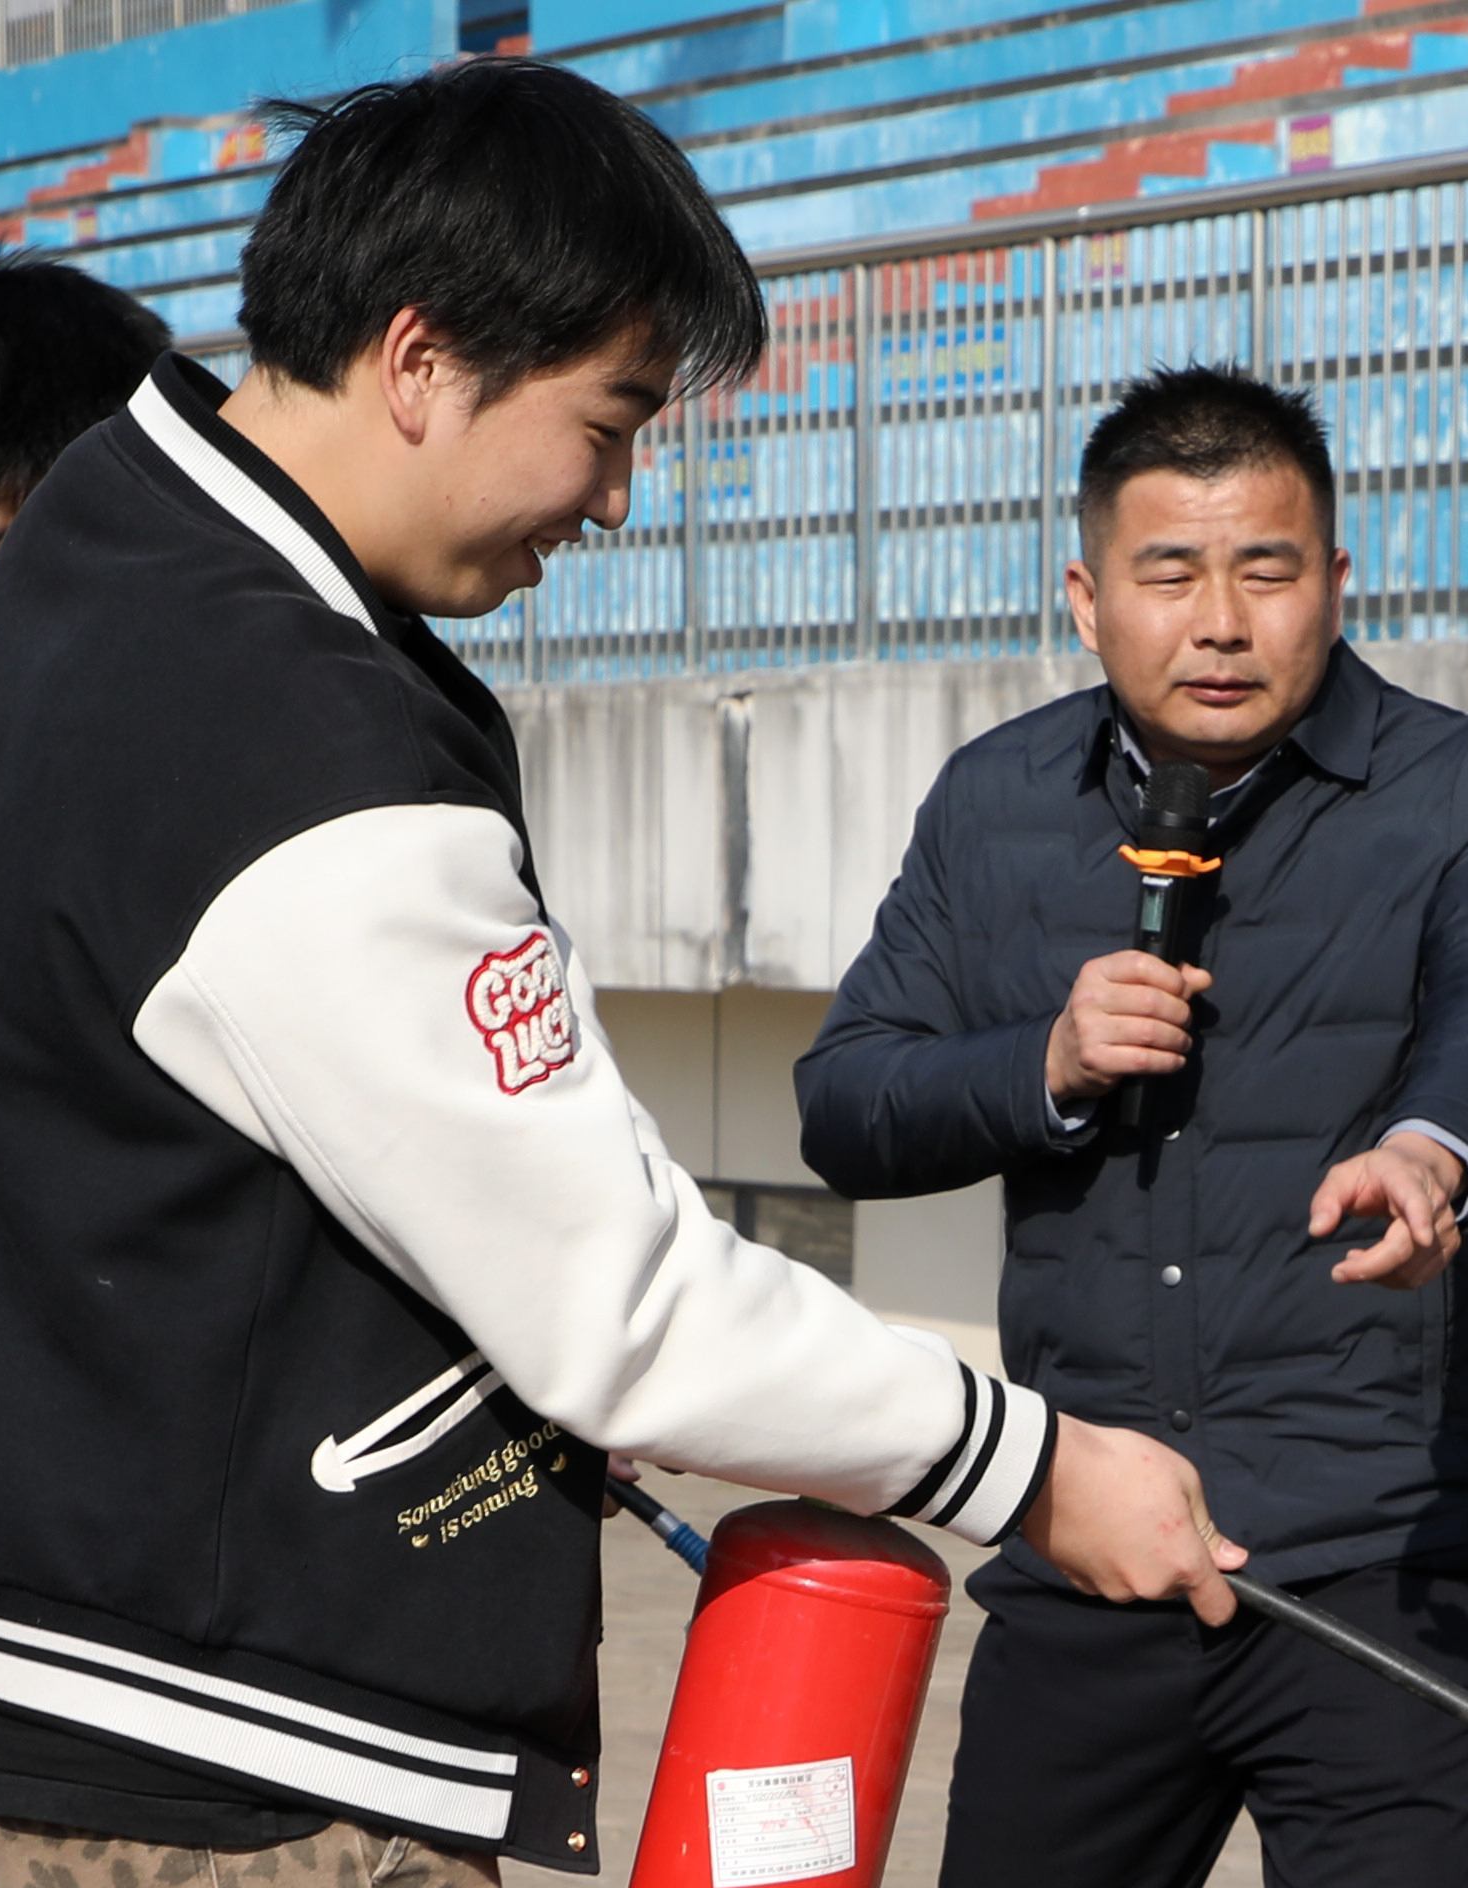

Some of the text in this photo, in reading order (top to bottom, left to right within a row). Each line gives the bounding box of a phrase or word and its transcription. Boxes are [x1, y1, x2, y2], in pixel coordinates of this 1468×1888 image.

[502, 1419, 562, 1473] good
[439, 1464, 539, 1544] is coming
